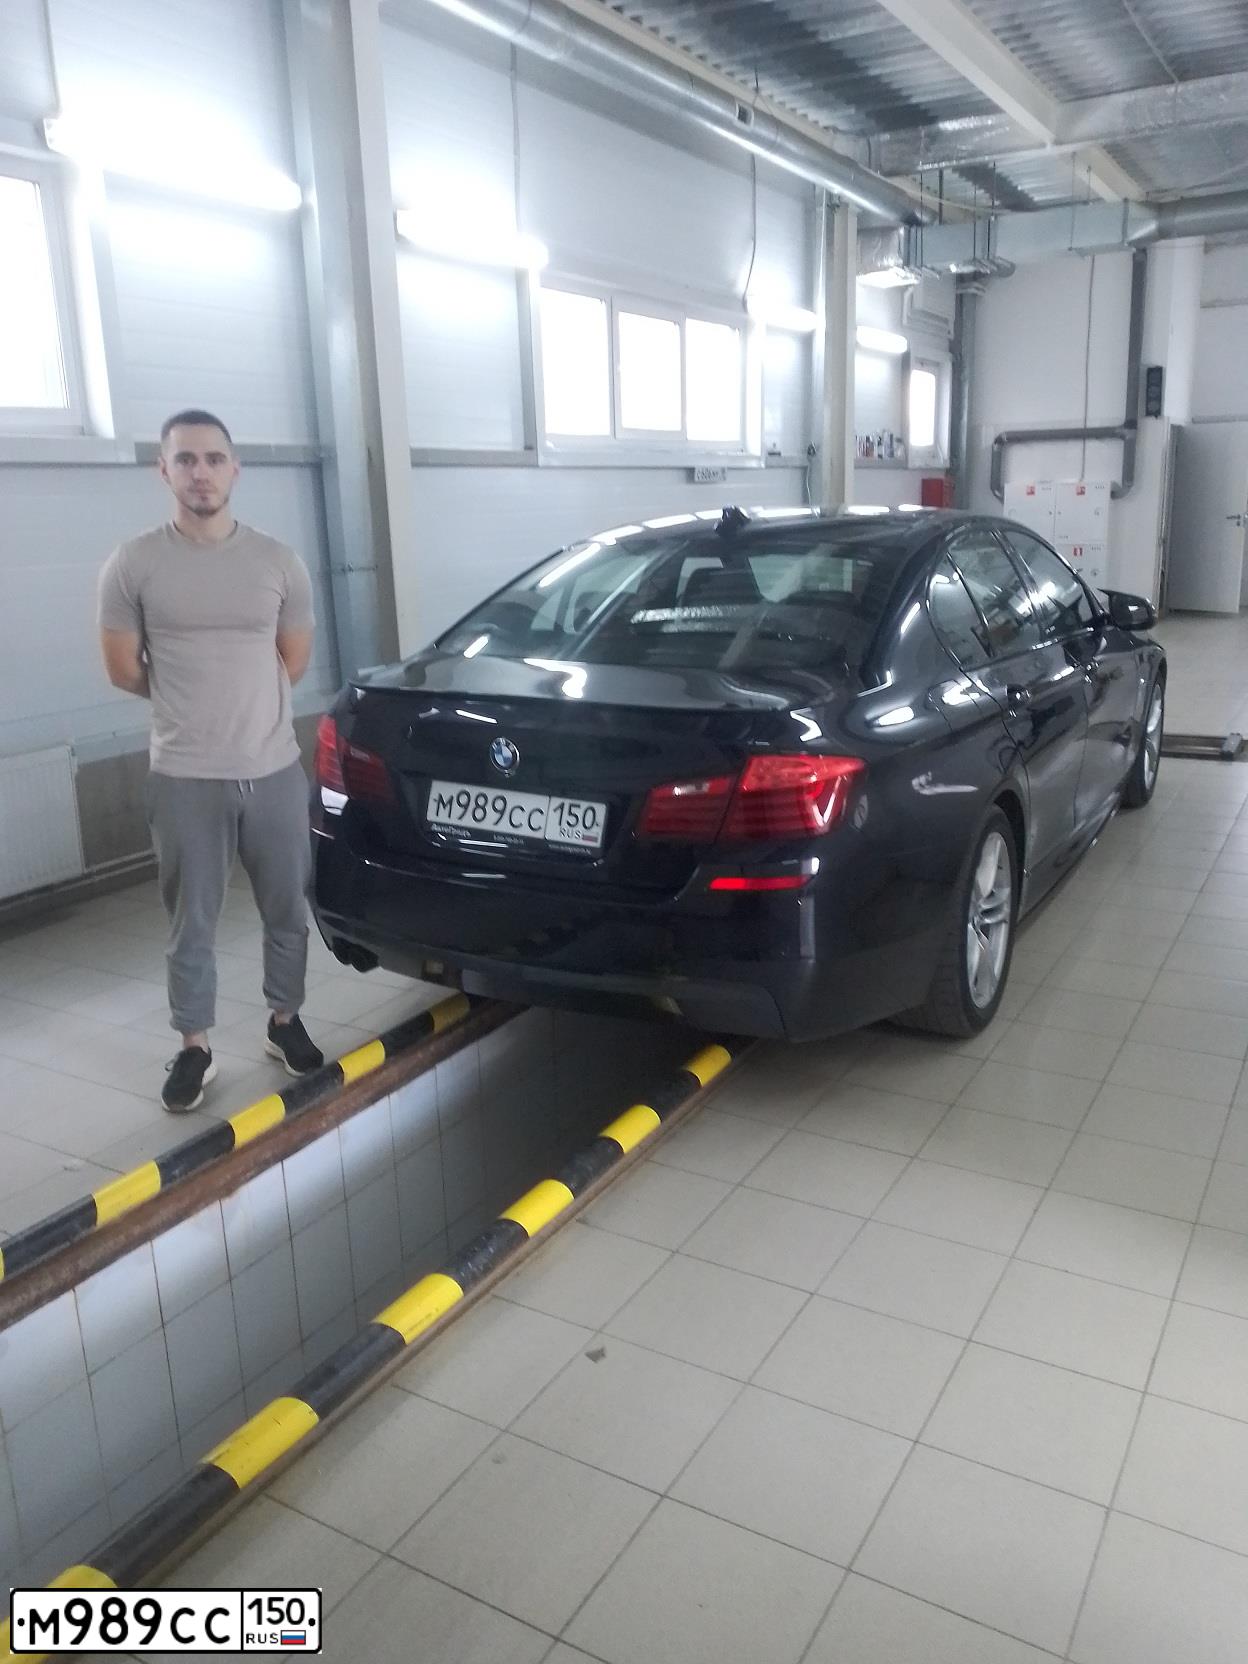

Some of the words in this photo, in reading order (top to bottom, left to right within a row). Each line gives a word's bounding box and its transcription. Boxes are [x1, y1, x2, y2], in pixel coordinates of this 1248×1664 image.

[436, 790, 545, 832] М989СС
[553, 802, 596, 830] 150
[560, 828, 581, 840] RUS
